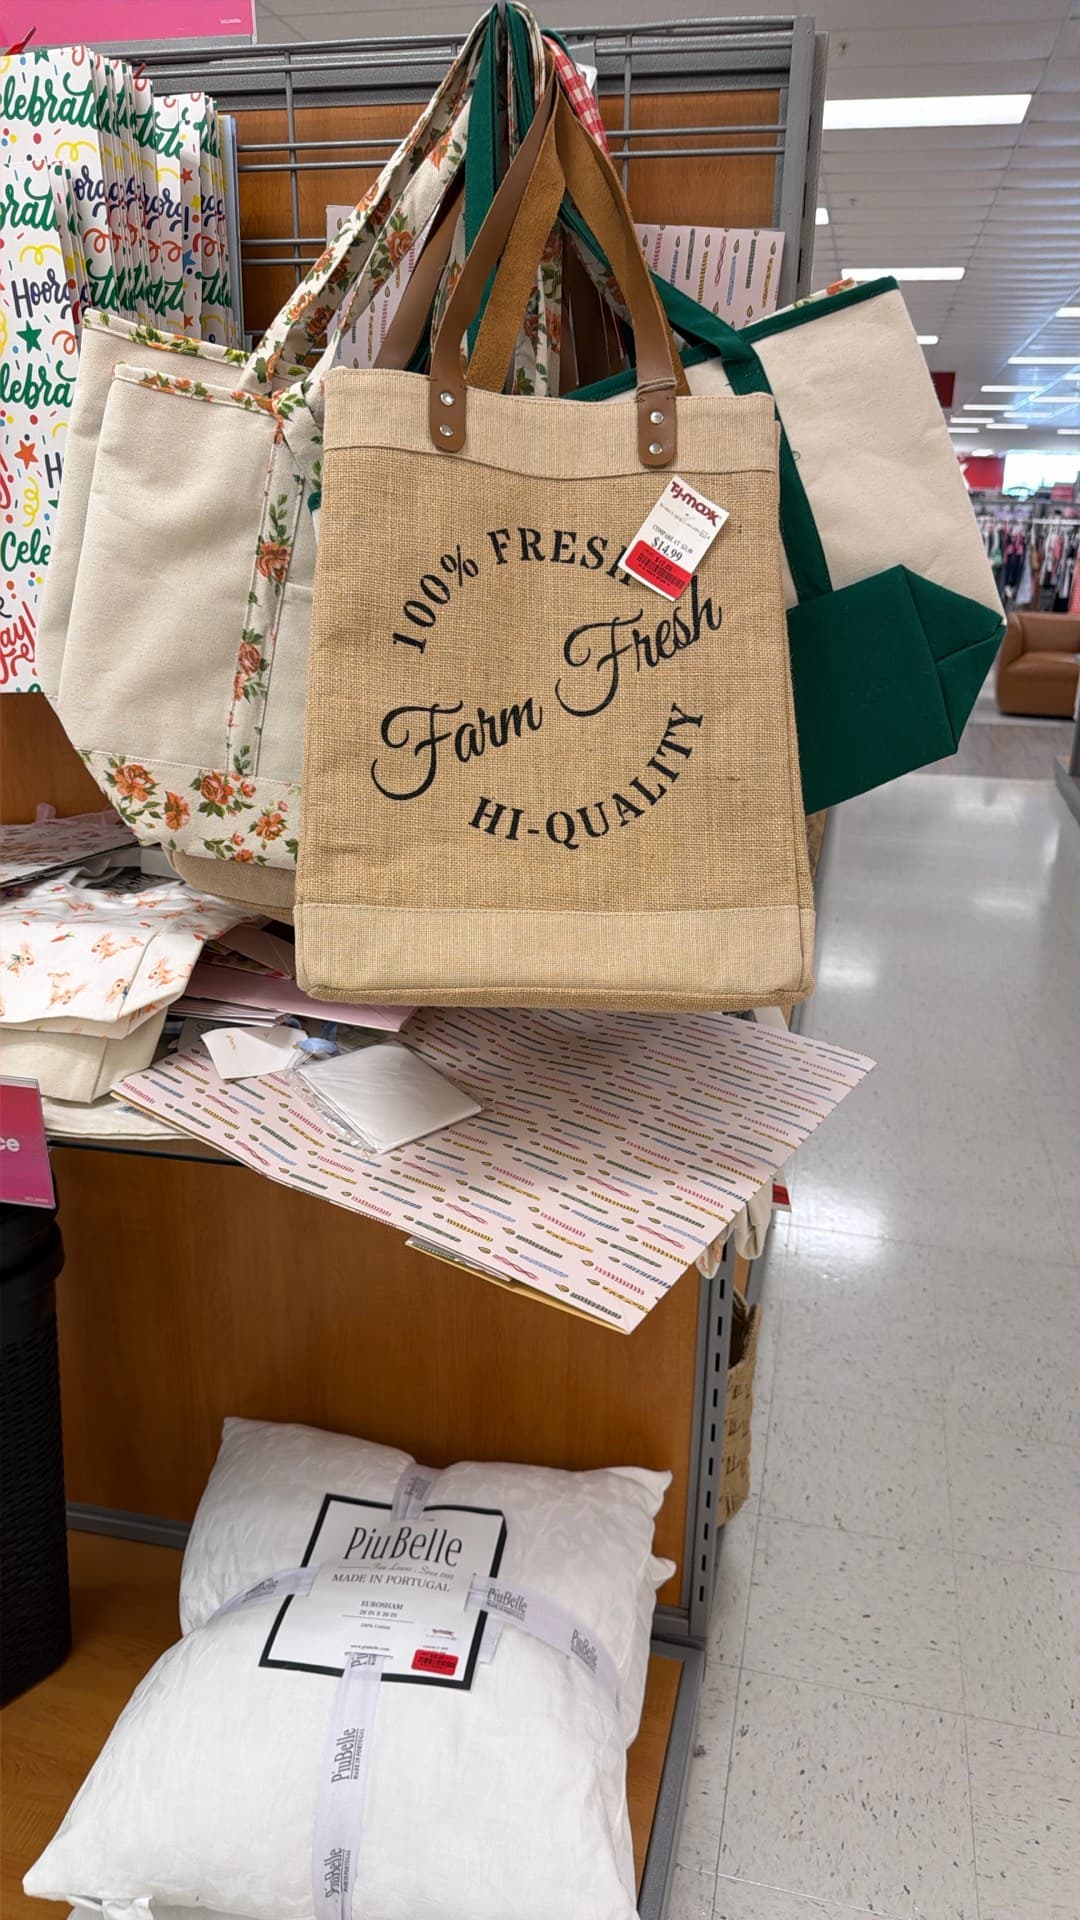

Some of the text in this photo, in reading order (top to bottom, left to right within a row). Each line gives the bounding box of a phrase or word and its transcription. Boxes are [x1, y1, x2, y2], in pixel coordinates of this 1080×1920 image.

[651, 536, 683, 562] $14.99
[392, 543, 479, 654] 100%
[371, 575, 722, 801] Farm Fresh
[468, 703, 703, 850] HI-QUALITY
[343, 1526, 463, 1567] PiuBelle
[332, 1573, 366, 1583] MADE
[369, 1574, 382, 1584] IN
[385, 1575, 450, 1592] PORTUGAL
[487, 1587, 528, 1614] PiuBelle
[331, 1727, 356, 1783] PiuBelle
